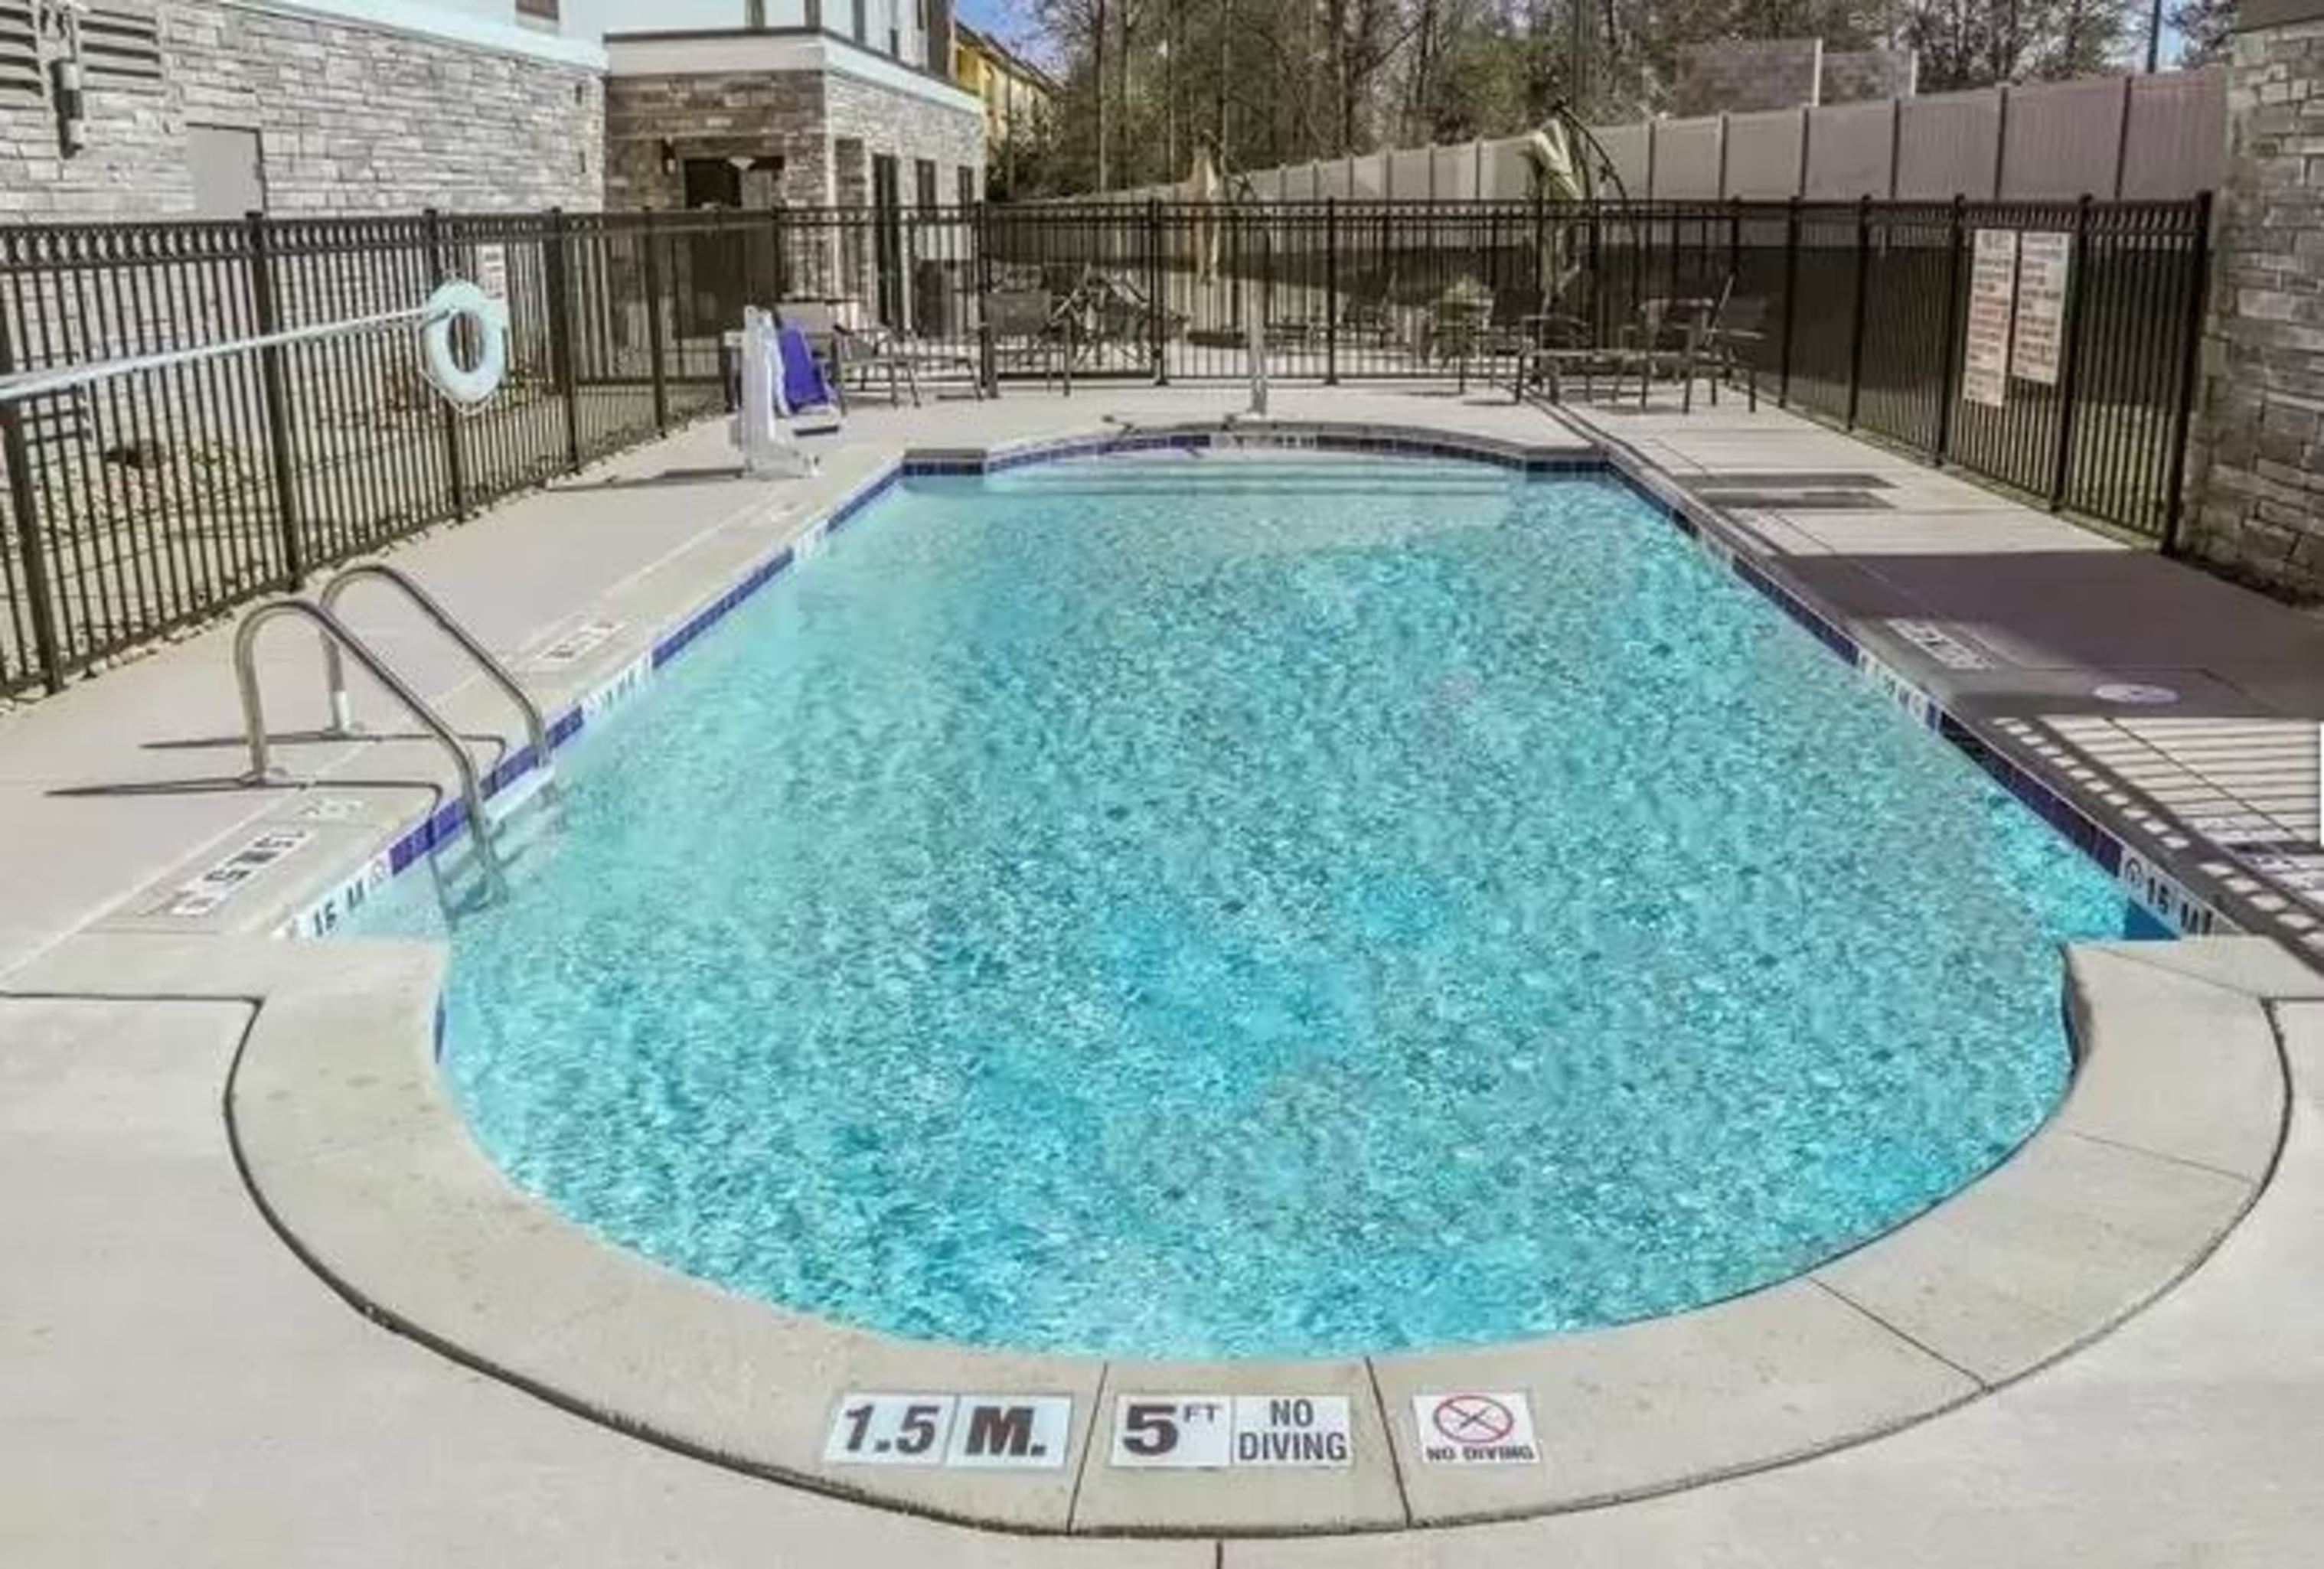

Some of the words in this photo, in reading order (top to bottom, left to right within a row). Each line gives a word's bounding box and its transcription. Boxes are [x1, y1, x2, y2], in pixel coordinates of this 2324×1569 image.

[1269, 1398, 1314, 1427] NO
[844, 1404, 942, 1455] 1.5
[965, 1405, 1046, 1456] M.
[1122, 1404, 1179, 1456] 5
[1183, 1403, 1222, 1424] FT
[1239, 1431, 1347, 1461] DIVING
[1426, 1445, 1456, 1461] NO
[1463, 1444, 1536, 1461] DIVING
